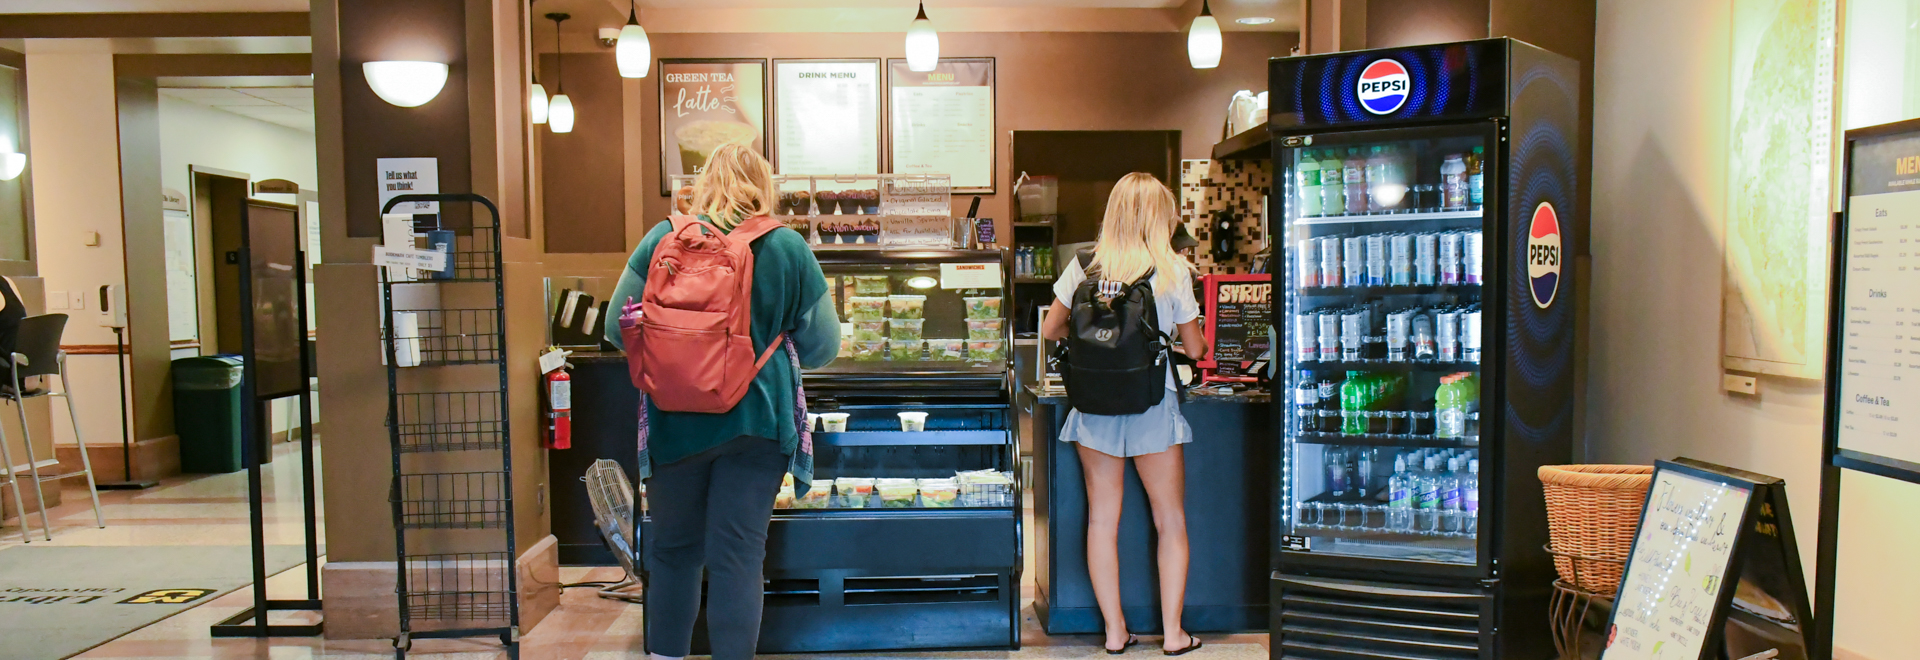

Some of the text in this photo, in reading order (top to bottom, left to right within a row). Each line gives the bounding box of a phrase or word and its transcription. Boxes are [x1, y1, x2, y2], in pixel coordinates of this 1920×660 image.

[666, 73, 734, 82] GREEN TEA
[928, 73, 954, 81] MENU
[1362, 80, 1406, 93] PEPSI
[1896, 156, 1920, 175] MEN
[386, 171, 394, 180] Tell
[403, 171, 418, 179] what
[386, 182, 414, 191] you think!
[890, 197, 916, 205] Original
[1876, 208, 1887, 217] Eats
[1530, 244, 1559, 266] PEPSI
[1218, 283, 1271, 303] SYRUP
[1869, 289, 1887, 298] Drinks
[1856, 394, 1890, 406] Coffee & Tea
[0, 595, 106, 604] Libr
